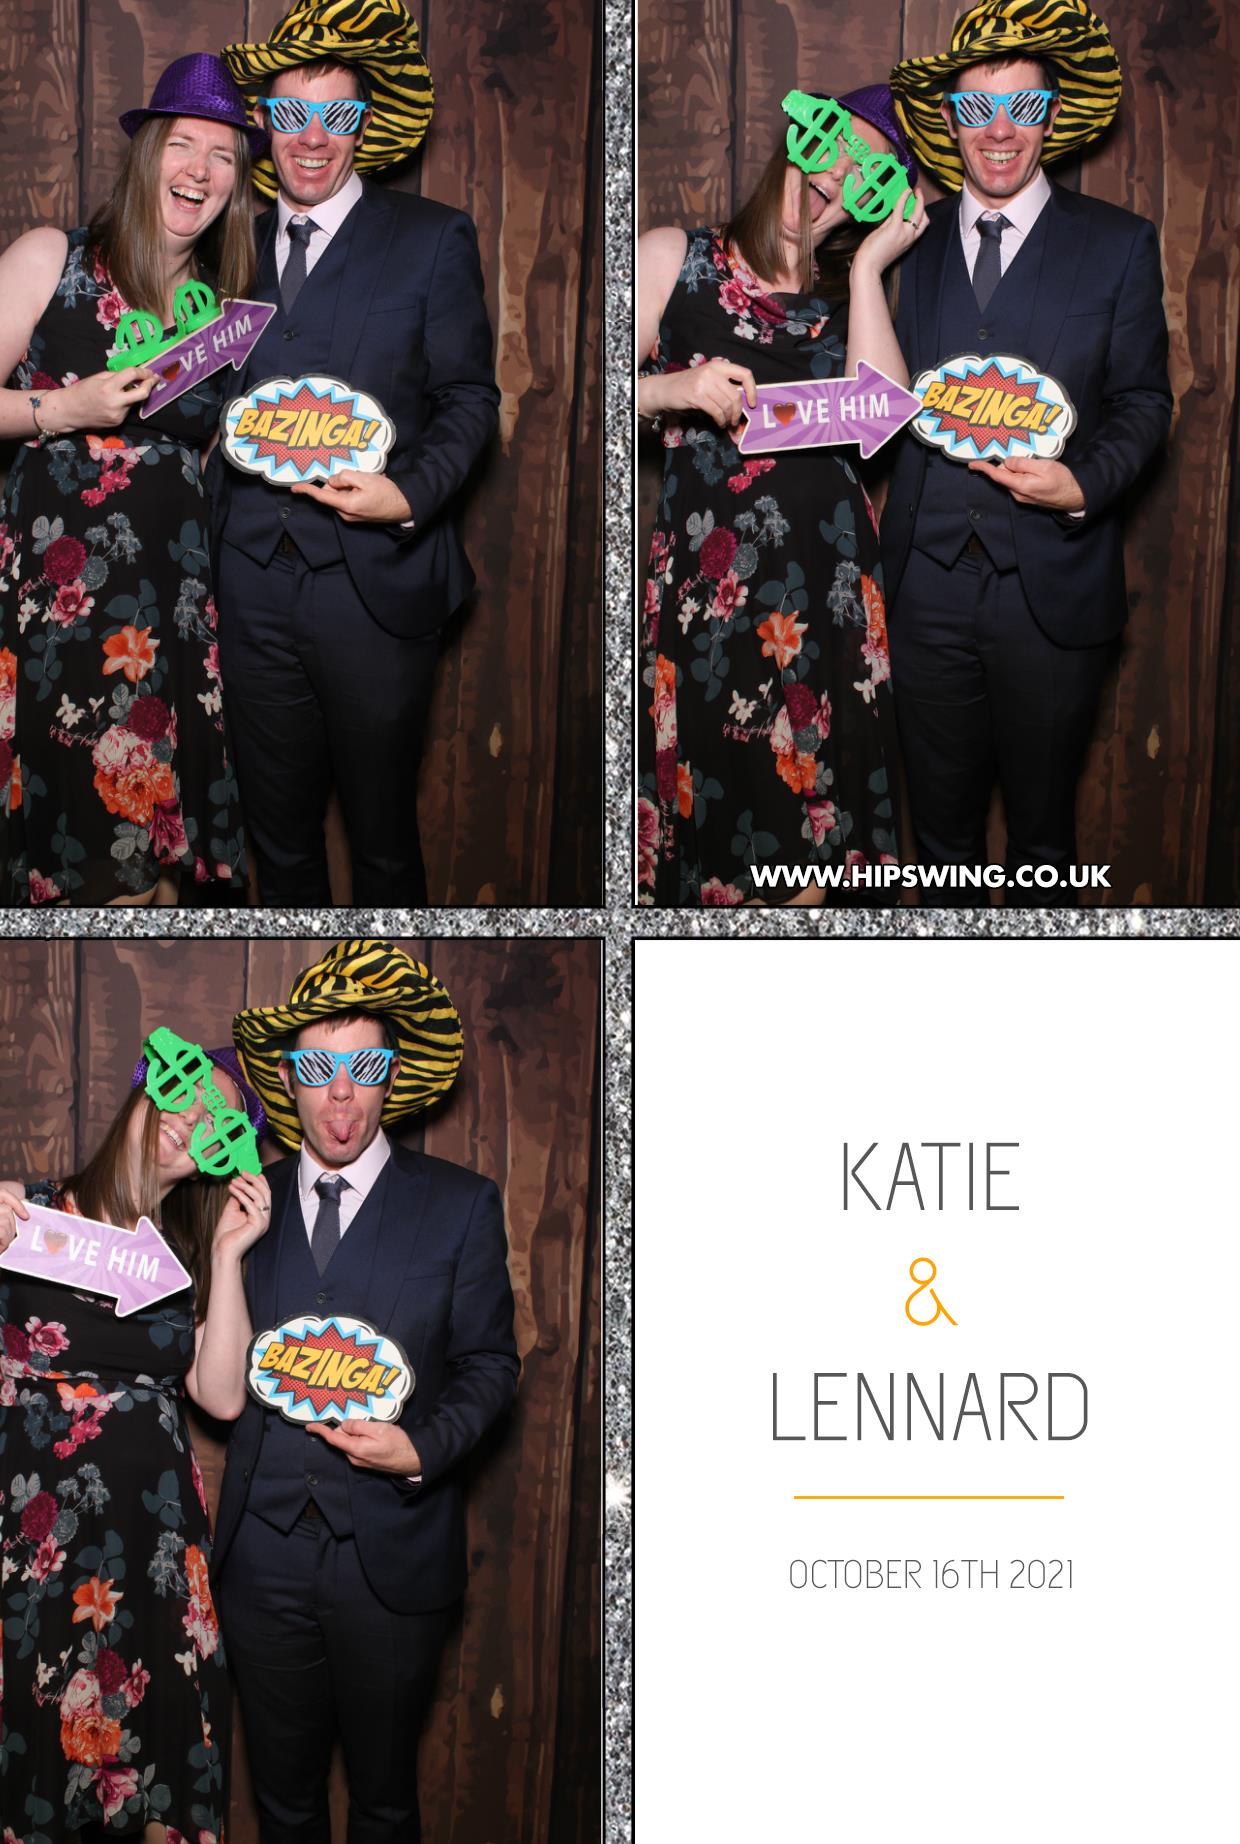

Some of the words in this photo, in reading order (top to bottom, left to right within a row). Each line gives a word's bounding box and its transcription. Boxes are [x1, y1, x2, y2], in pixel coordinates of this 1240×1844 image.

[212, 304, 253, 353] HIM
[234, 407, 382, 451] BAZINGA!
[839, 392, 890, 421] HIM
[921, 380, 1064, 435] BAZINGA!
[107, 1245, 161, 1284] HIM
[257, 1341, 403, 1396] BAZINGA!
